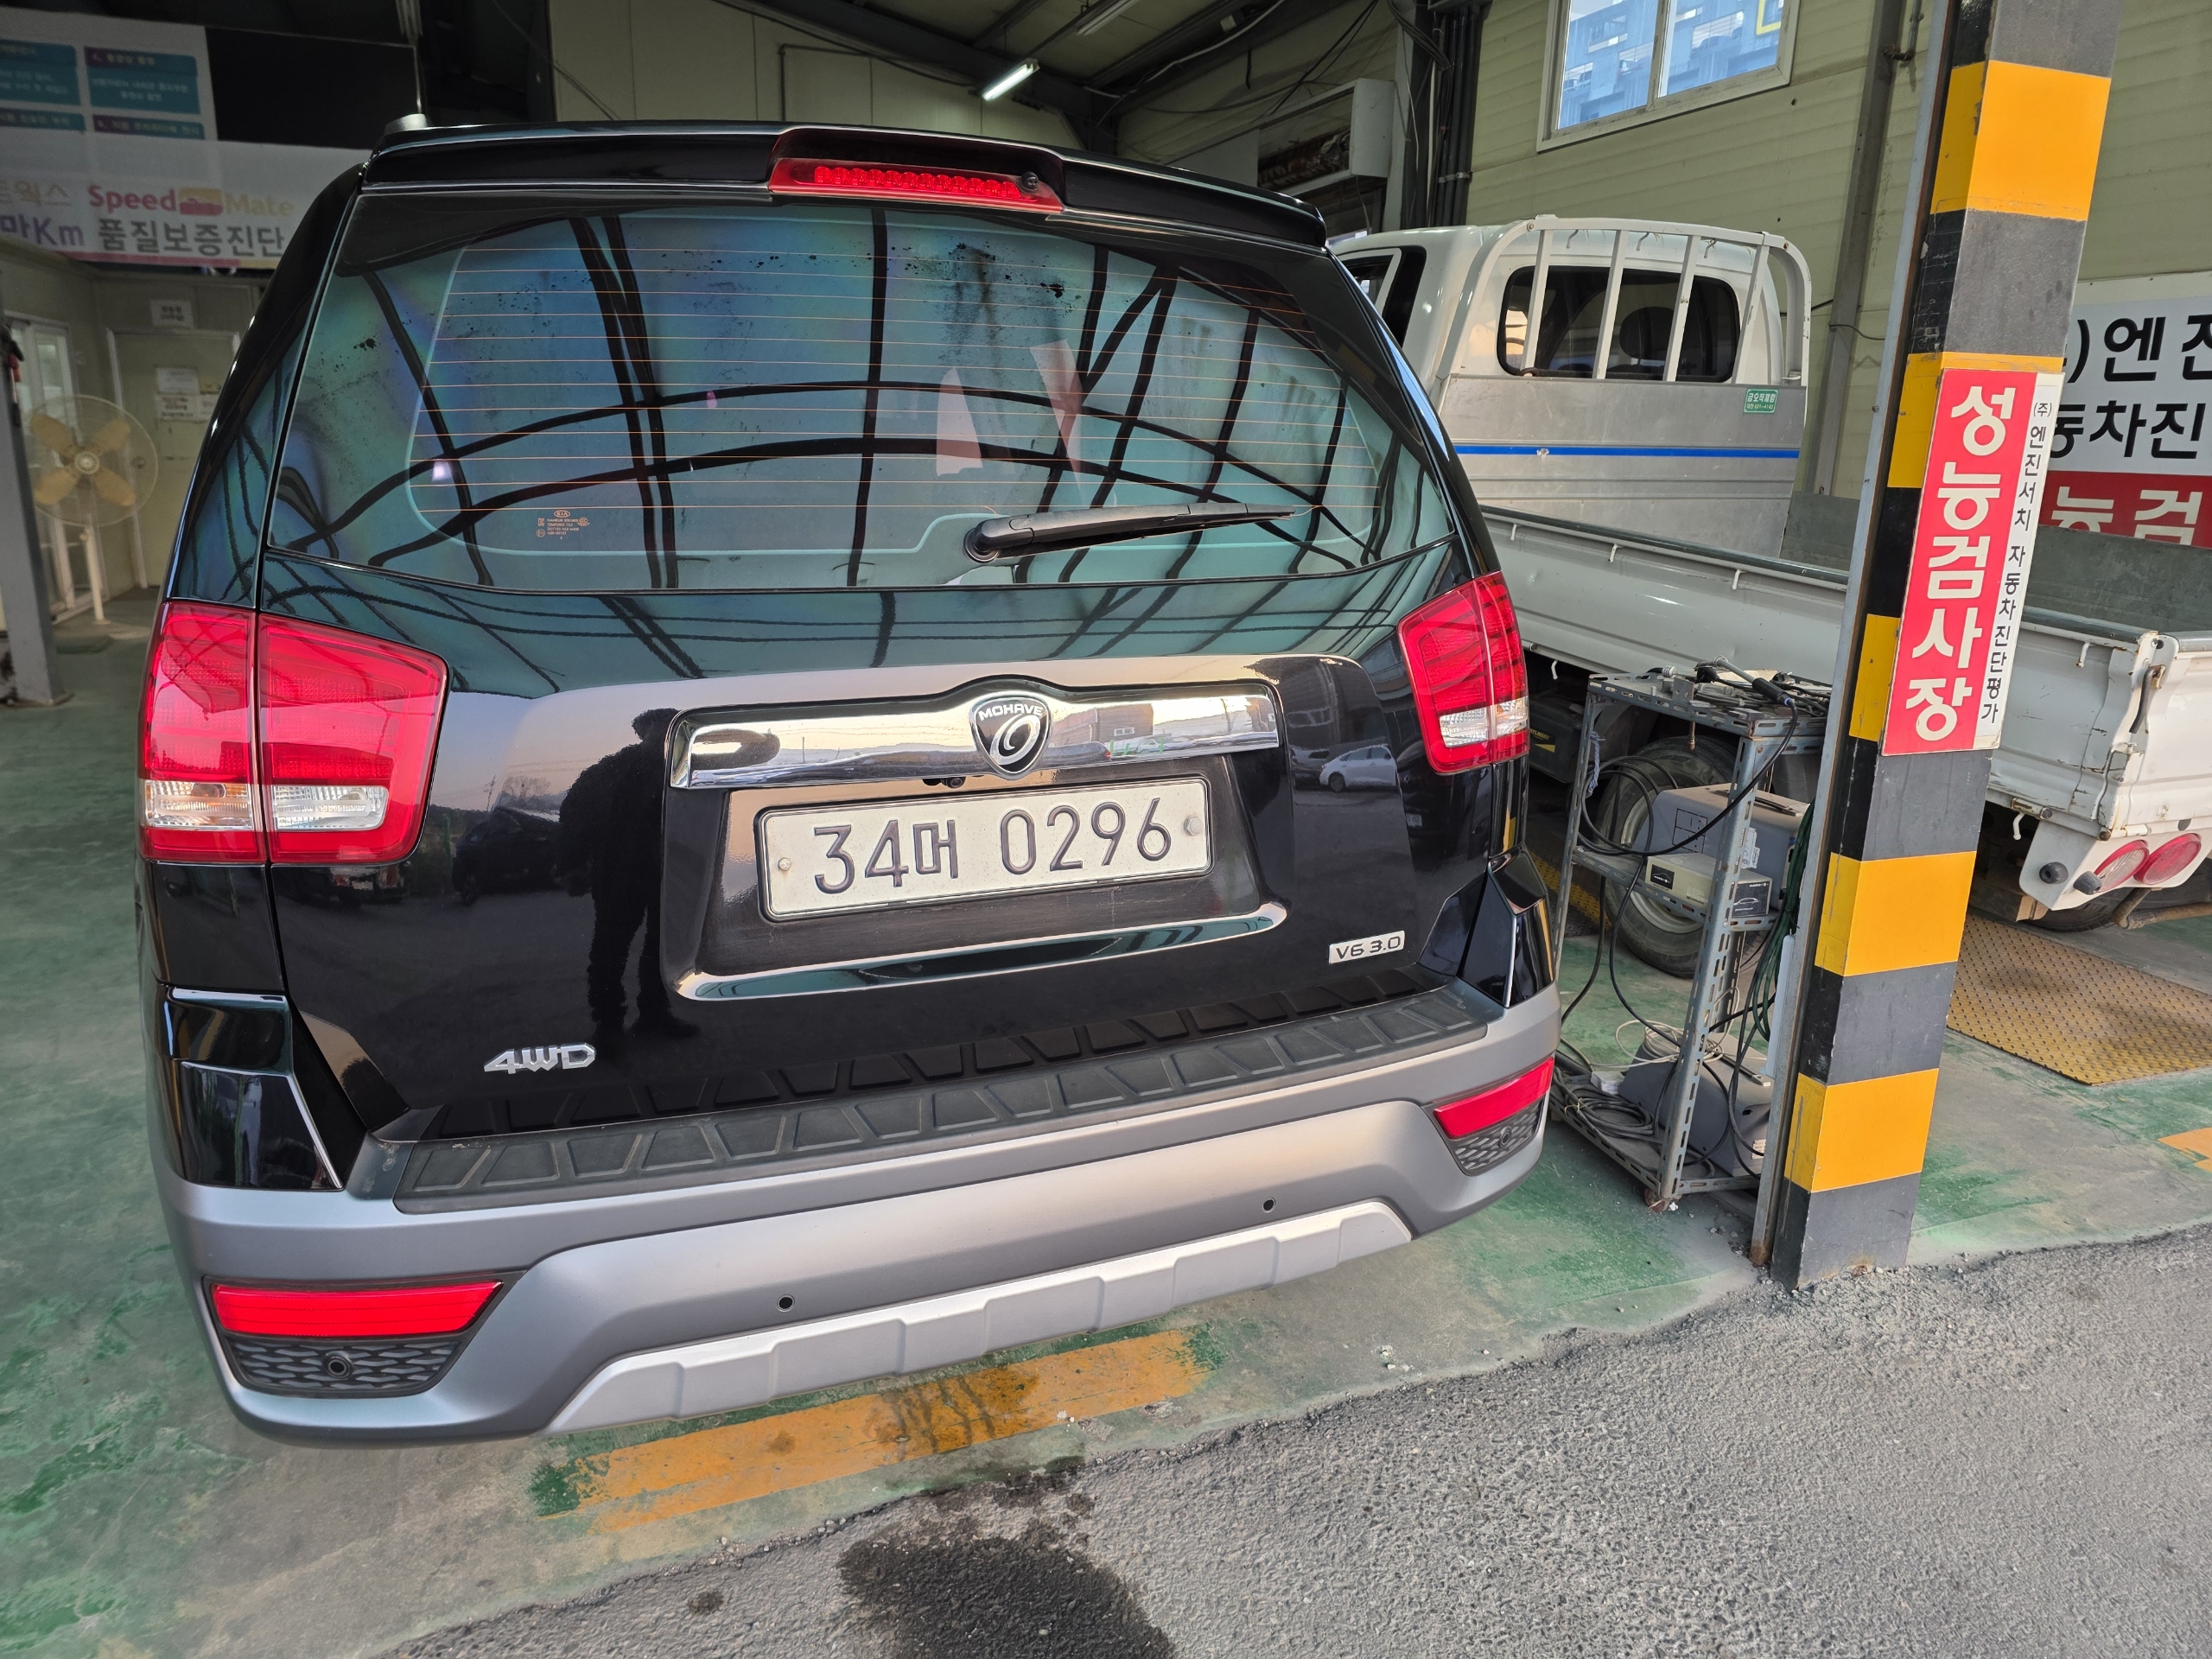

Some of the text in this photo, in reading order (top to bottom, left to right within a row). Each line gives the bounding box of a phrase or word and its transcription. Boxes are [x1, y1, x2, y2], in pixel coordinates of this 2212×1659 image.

[87, 184, 294, 215] Speed Mate
[98, 218, 285, 257] 품질보증진단
[1905, 385, 2013, 741] 성능검사장
[977, 702, 1044, 721] MOHAVE
[813, 797, 1173, 895] 34머 0296
[1335, 936, 1402, 960] V6 3.0
[483, 1042, 597, 1075] 4WD
